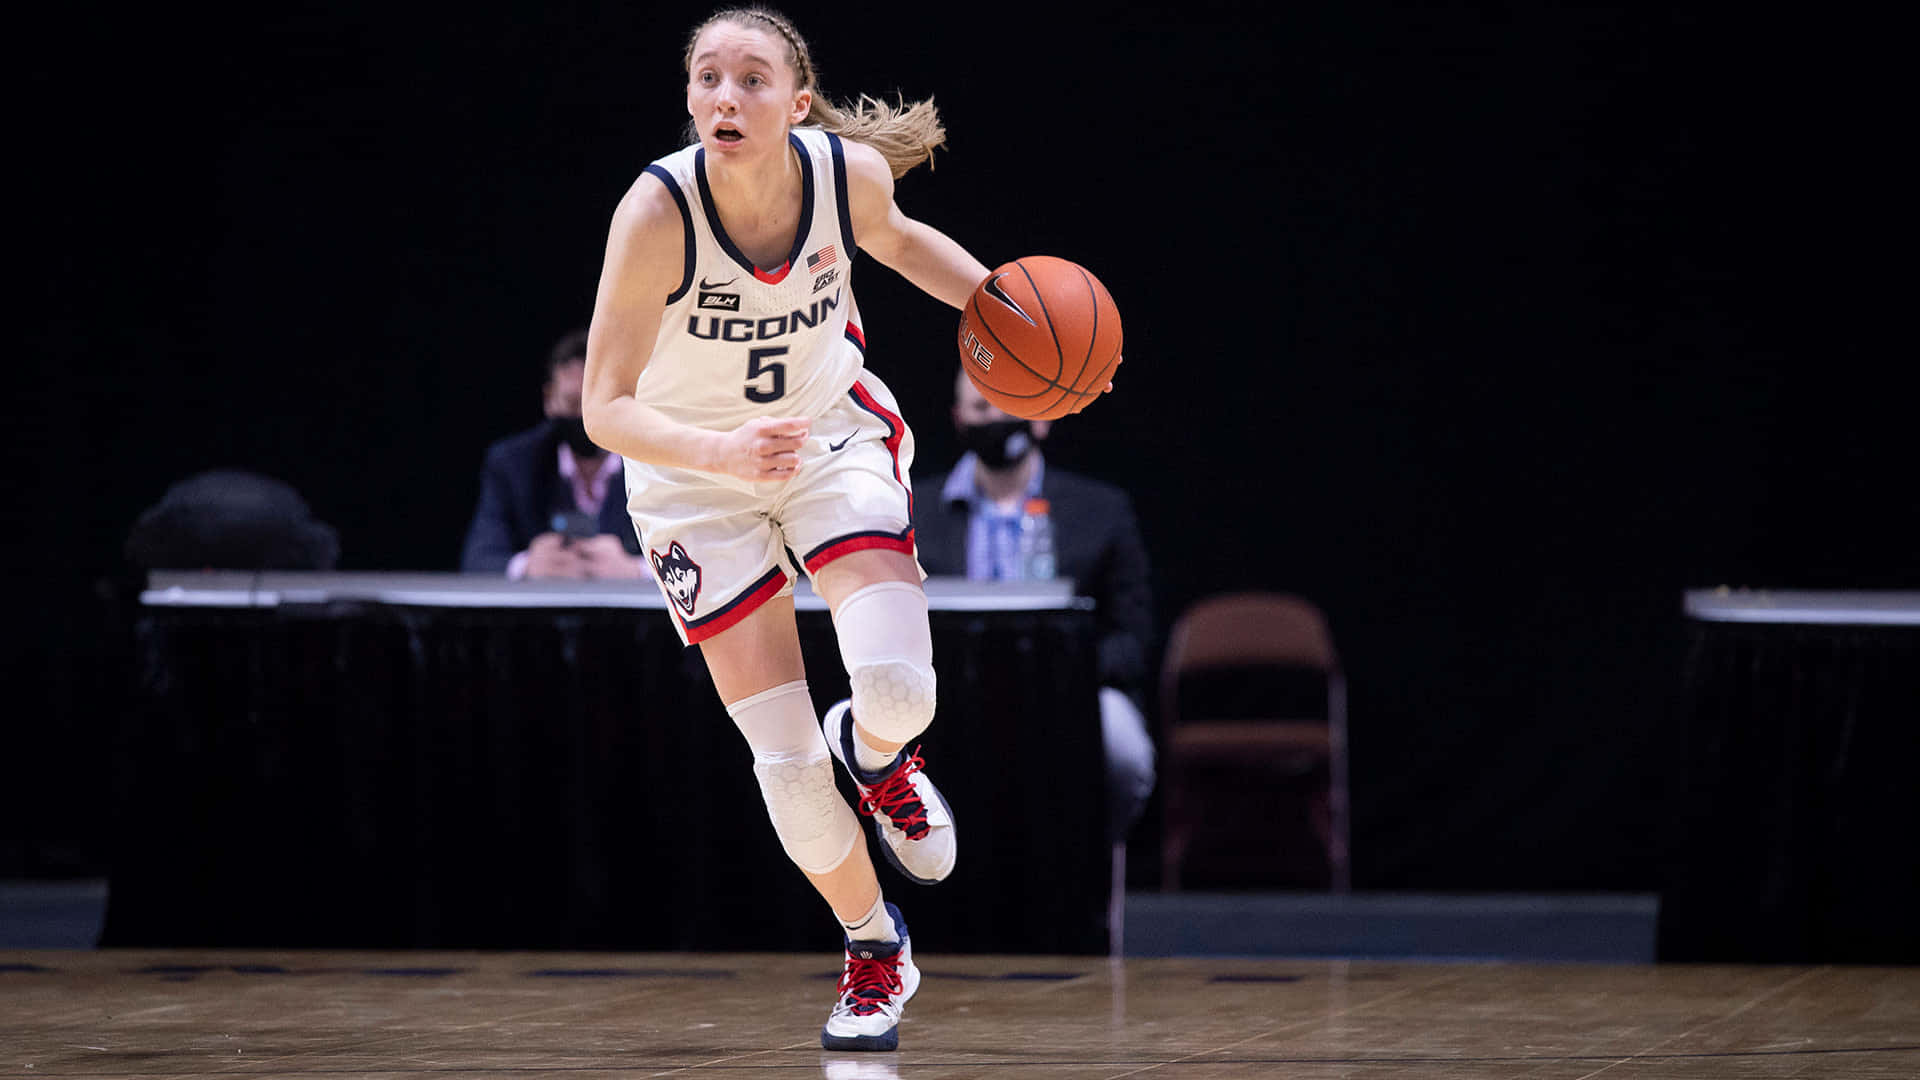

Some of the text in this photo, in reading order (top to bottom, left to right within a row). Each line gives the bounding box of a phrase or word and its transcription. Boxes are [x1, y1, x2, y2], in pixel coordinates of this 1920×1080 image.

[687, 287, 841, 342] UCONN
[703, 295, 737, 305] BLM
[744, 344, 790, 404] 5
